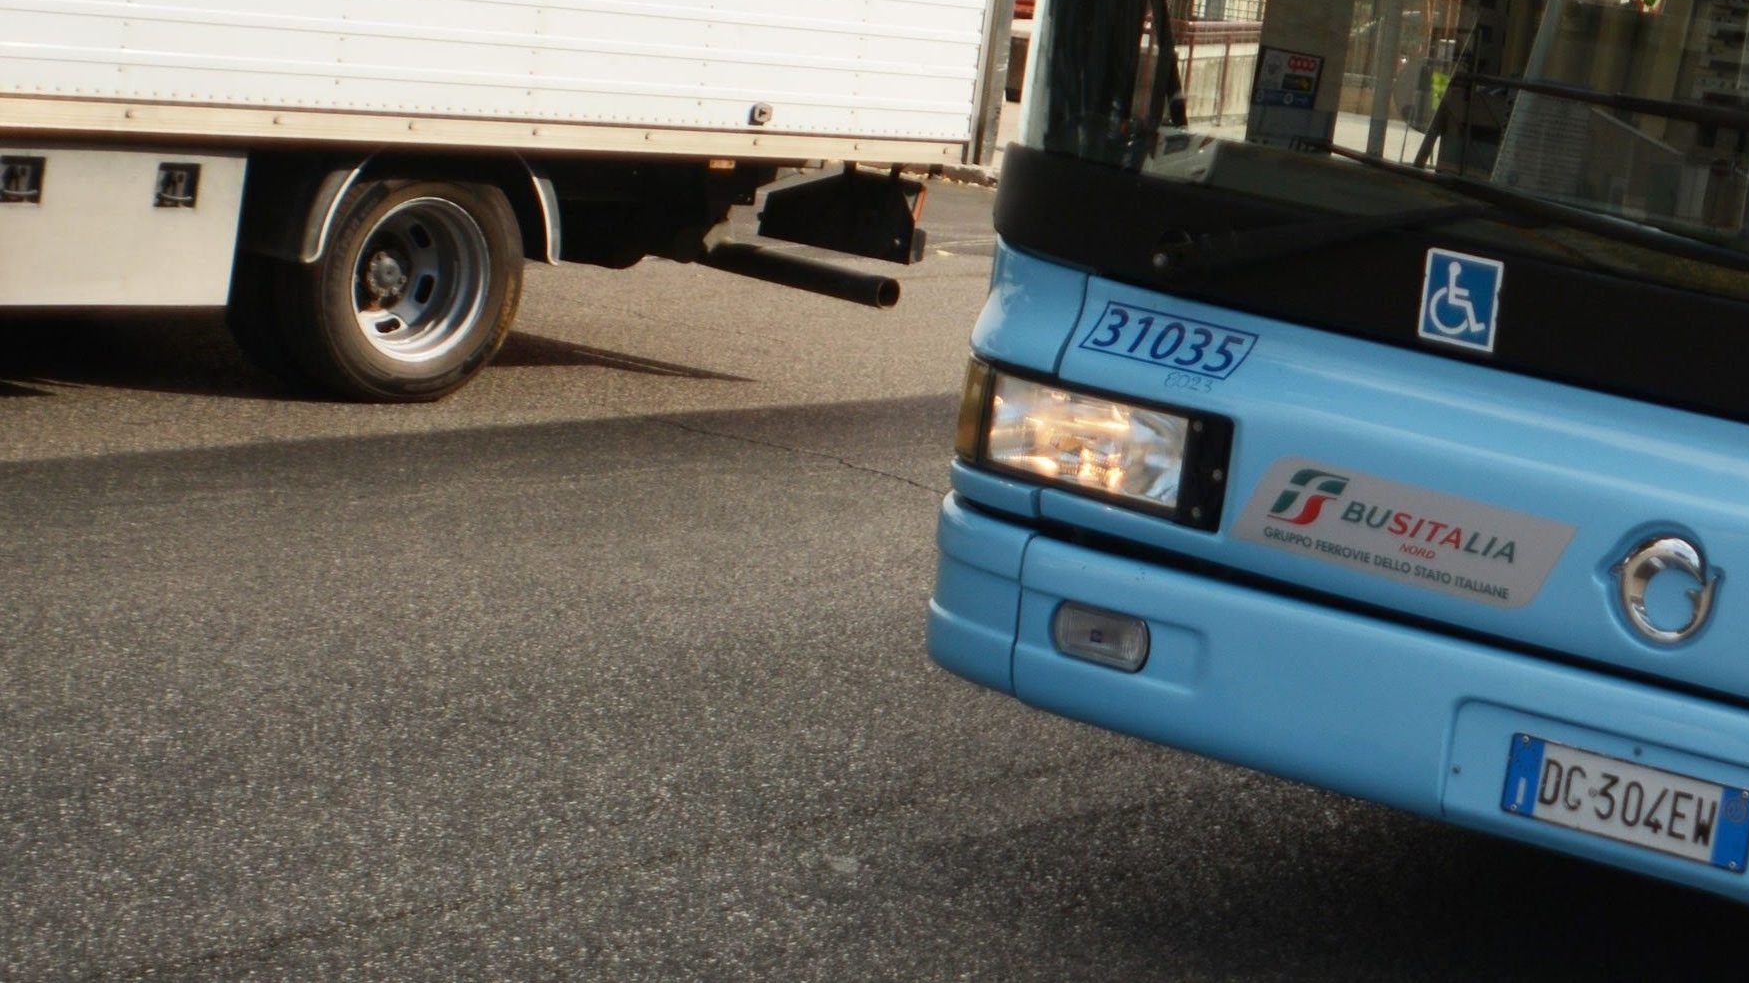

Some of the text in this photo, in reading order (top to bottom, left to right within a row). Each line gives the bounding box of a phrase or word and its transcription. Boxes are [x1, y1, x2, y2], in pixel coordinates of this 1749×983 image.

[1092, 308, 1245, 372] 31035
[1263, 526, 1510, 600] GRUPPO FERROVIE DELLO STATO ITALIANE
[1341, 500, 1517, 564] BUSITALIA
[1399, 544, 1436, 560] NORD
